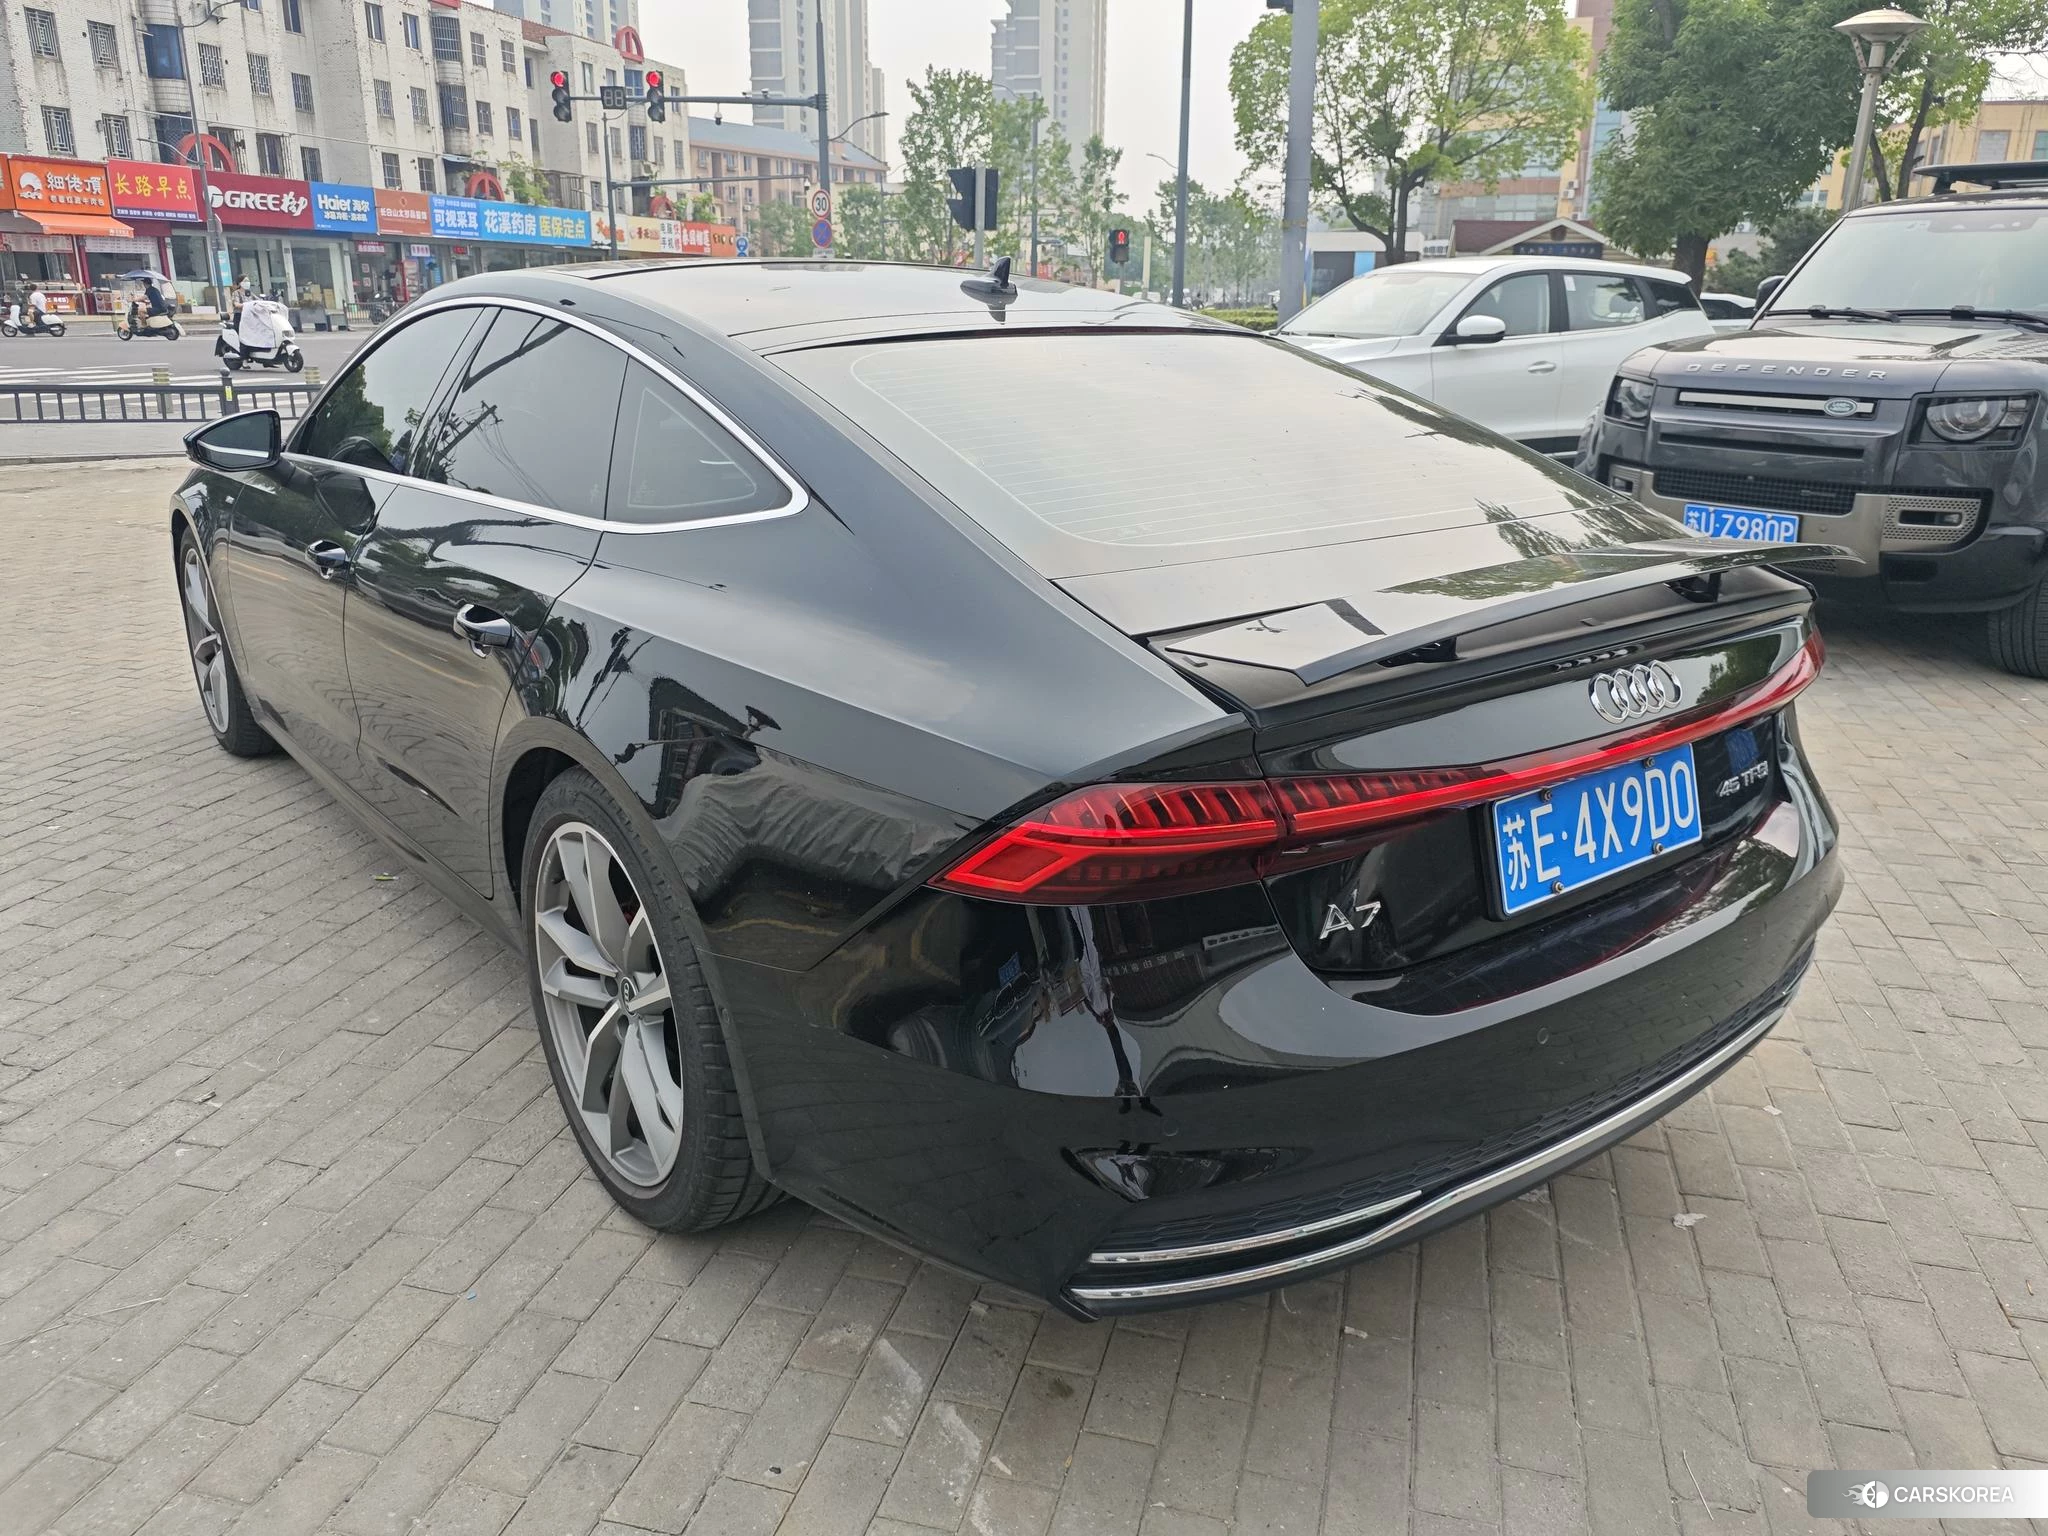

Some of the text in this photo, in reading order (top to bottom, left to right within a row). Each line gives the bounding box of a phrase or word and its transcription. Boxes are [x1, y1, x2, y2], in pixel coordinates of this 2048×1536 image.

[115, 172, 192, 201] 长路早点
[224, 190, 280, 211] GREE
[317, 194, 370, 212] Haier 海尔
[815, 197, 828, 211] 30
[433, 209, 478, 230] 可视采耳
[484, 209, 537, 236] 花溪药房
[540, 215, 586, 239] 医保定点
[1686, 364, 1887, 380] DEFENDER
[1718, 776, 1740, 797] 45
[1319, 901, 1381, 939] A7
